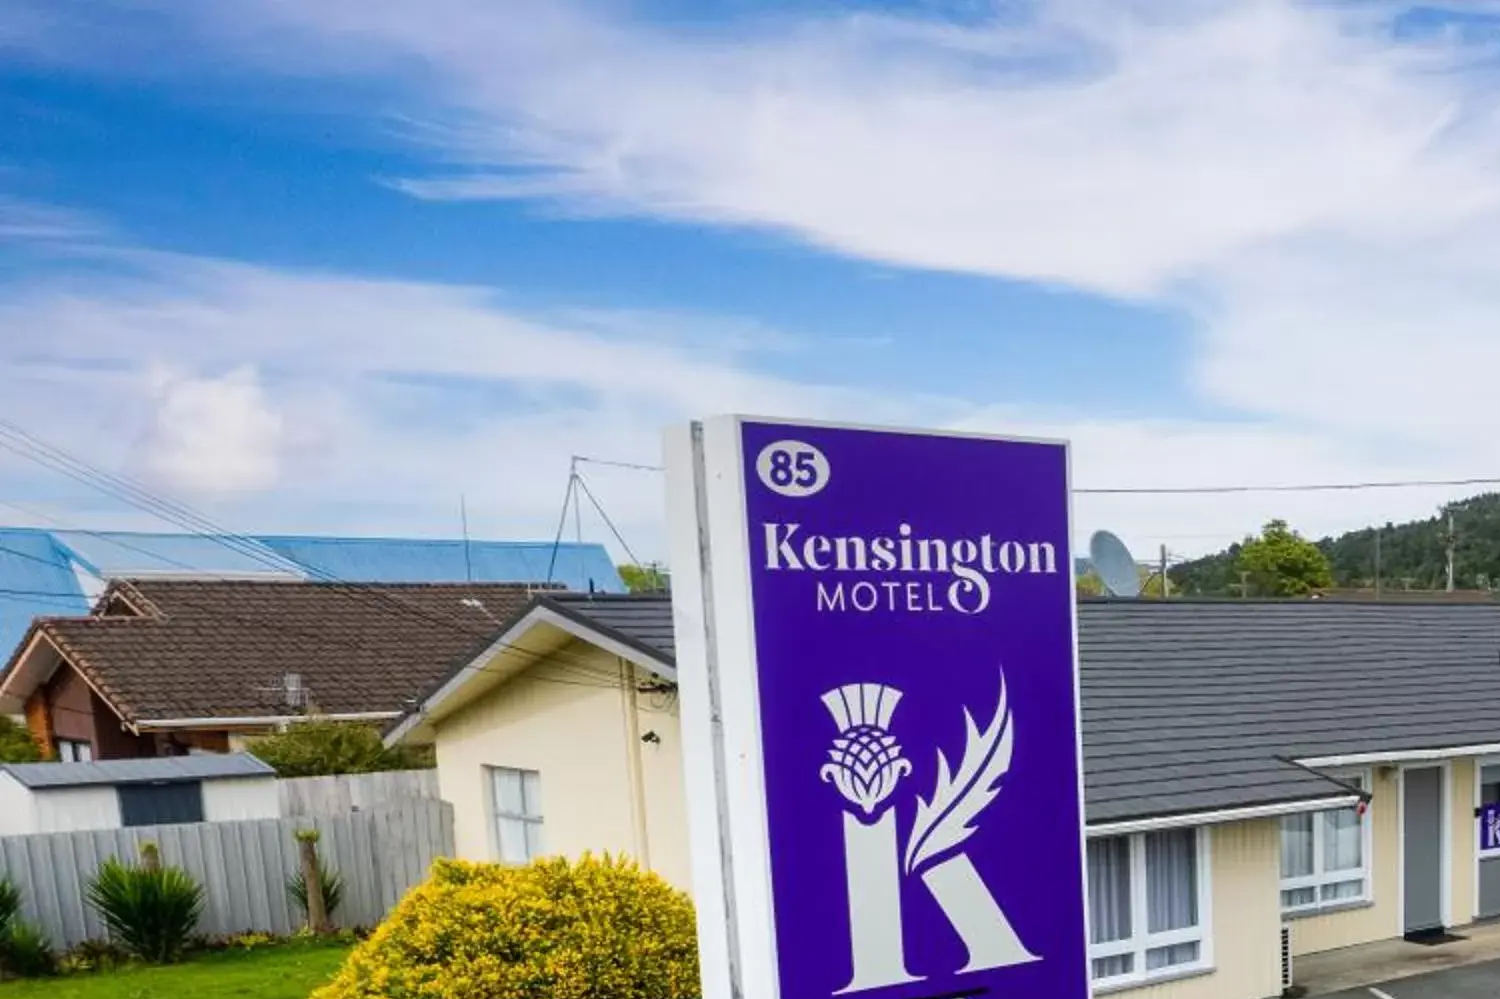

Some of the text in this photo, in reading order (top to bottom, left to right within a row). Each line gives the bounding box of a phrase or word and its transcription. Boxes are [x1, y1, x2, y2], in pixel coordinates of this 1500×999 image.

[768, 449, 818, 488] 85
[762, 522, 1058, 615] Kensington
[816, 581, 943, 612] MOTEL
